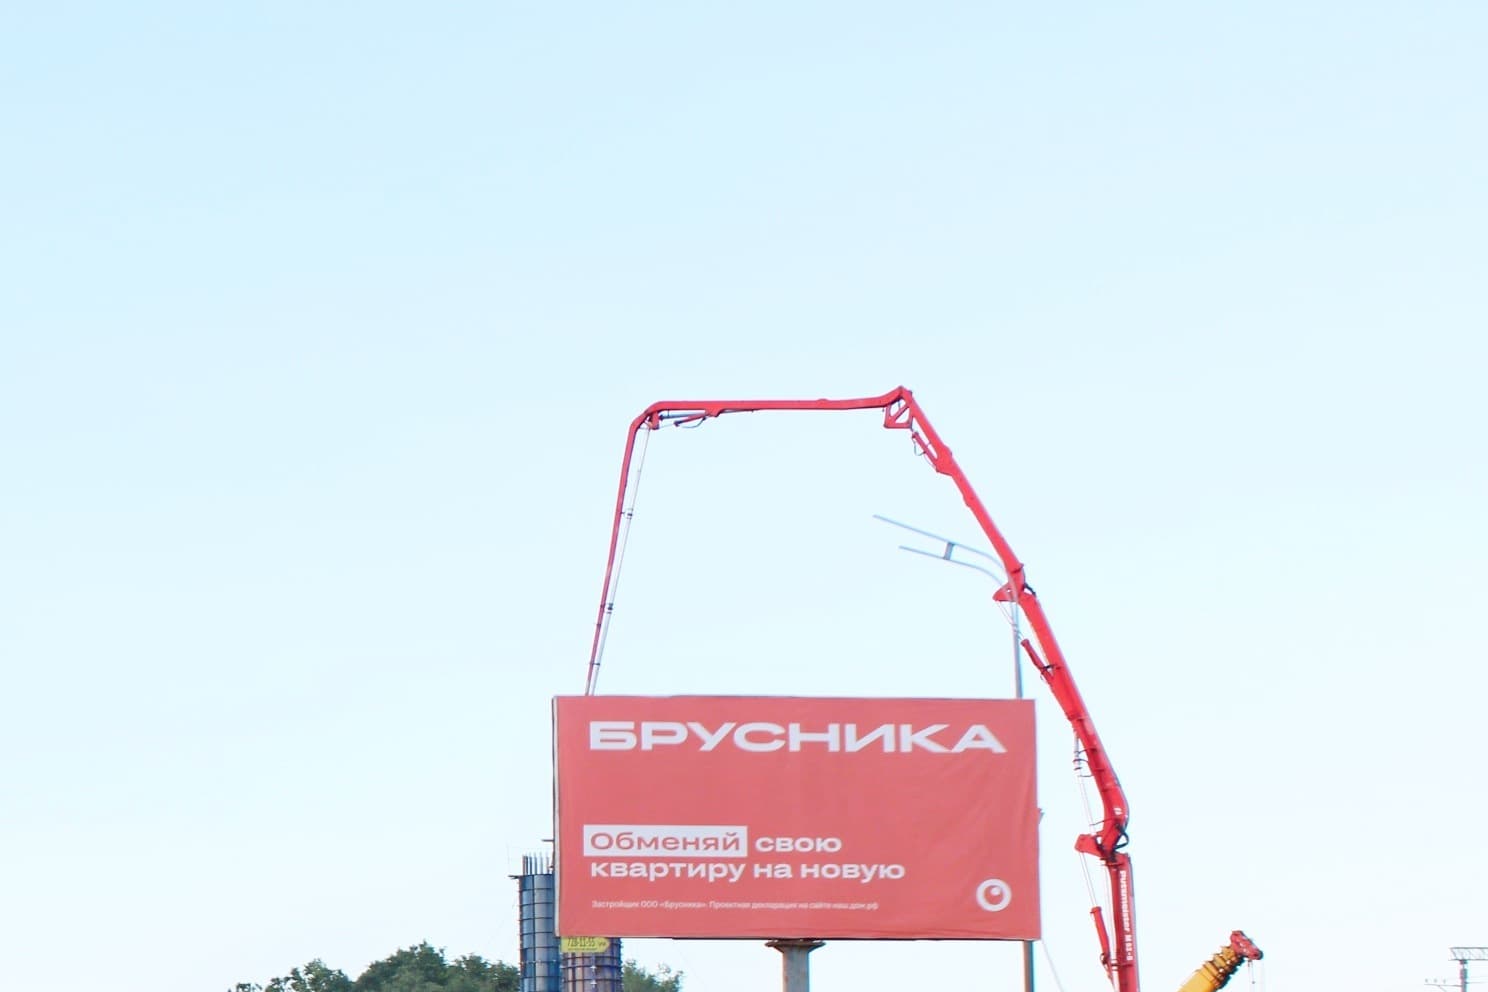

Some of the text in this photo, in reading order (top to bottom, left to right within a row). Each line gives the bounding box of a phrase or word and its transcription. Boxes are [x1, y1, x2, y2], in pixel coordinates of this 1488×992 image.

[589, 721, 1007, 753] БРУСНИКА
[590, 832, 842, 852] Обменяй свою
[591, 861, 905, 883] квартиру на новую
